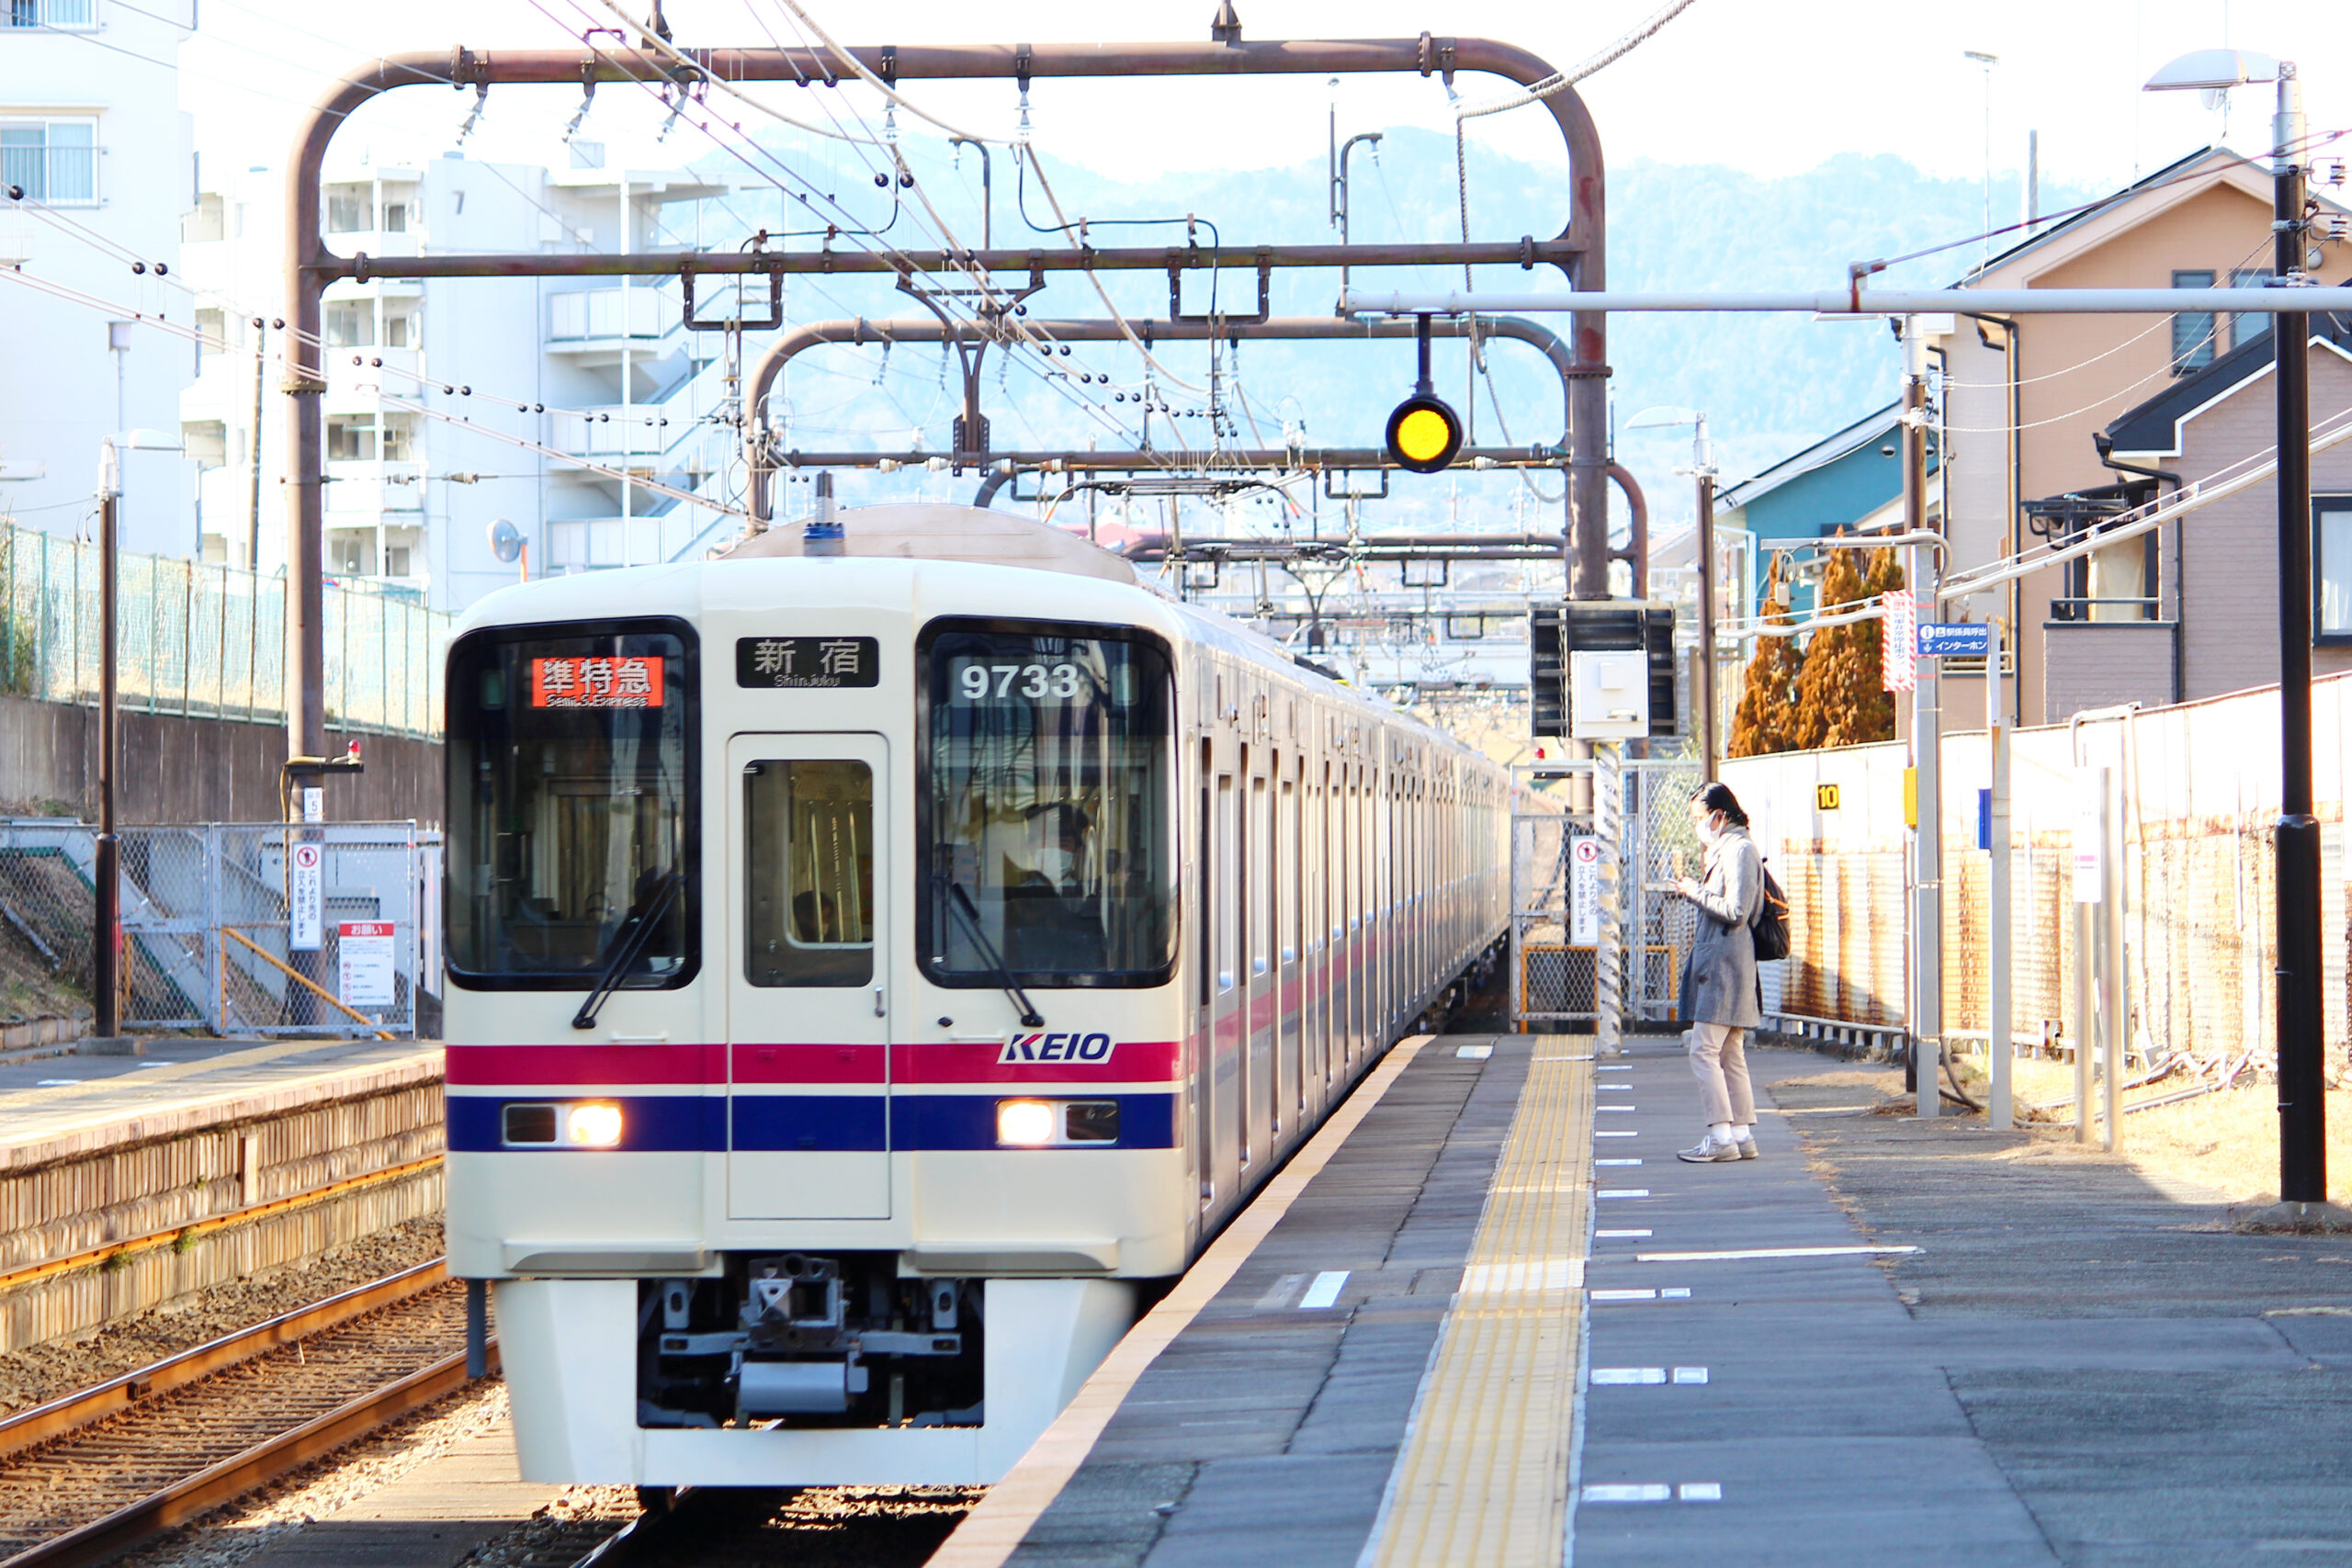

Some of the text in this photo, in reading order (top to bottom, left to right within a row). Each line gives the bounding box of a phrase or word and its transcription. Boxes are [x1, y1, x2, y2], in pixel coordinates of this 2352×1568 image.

[754, 639, 861, 674] 新宿
[1936, 640, 1987, 650] インターホン
[542, 658, 651, 694] 準特急
[774, 673, 841, 687] Shinjuku
[961, 663, 1080, 699] 9733
[311, 800, 318, 812] 5
[1819, 785, 1838, 808] 10
[1577, 865, 1586, 934] 立入を禁止します
[1005, 1032, 1110, 1060] KEIO
